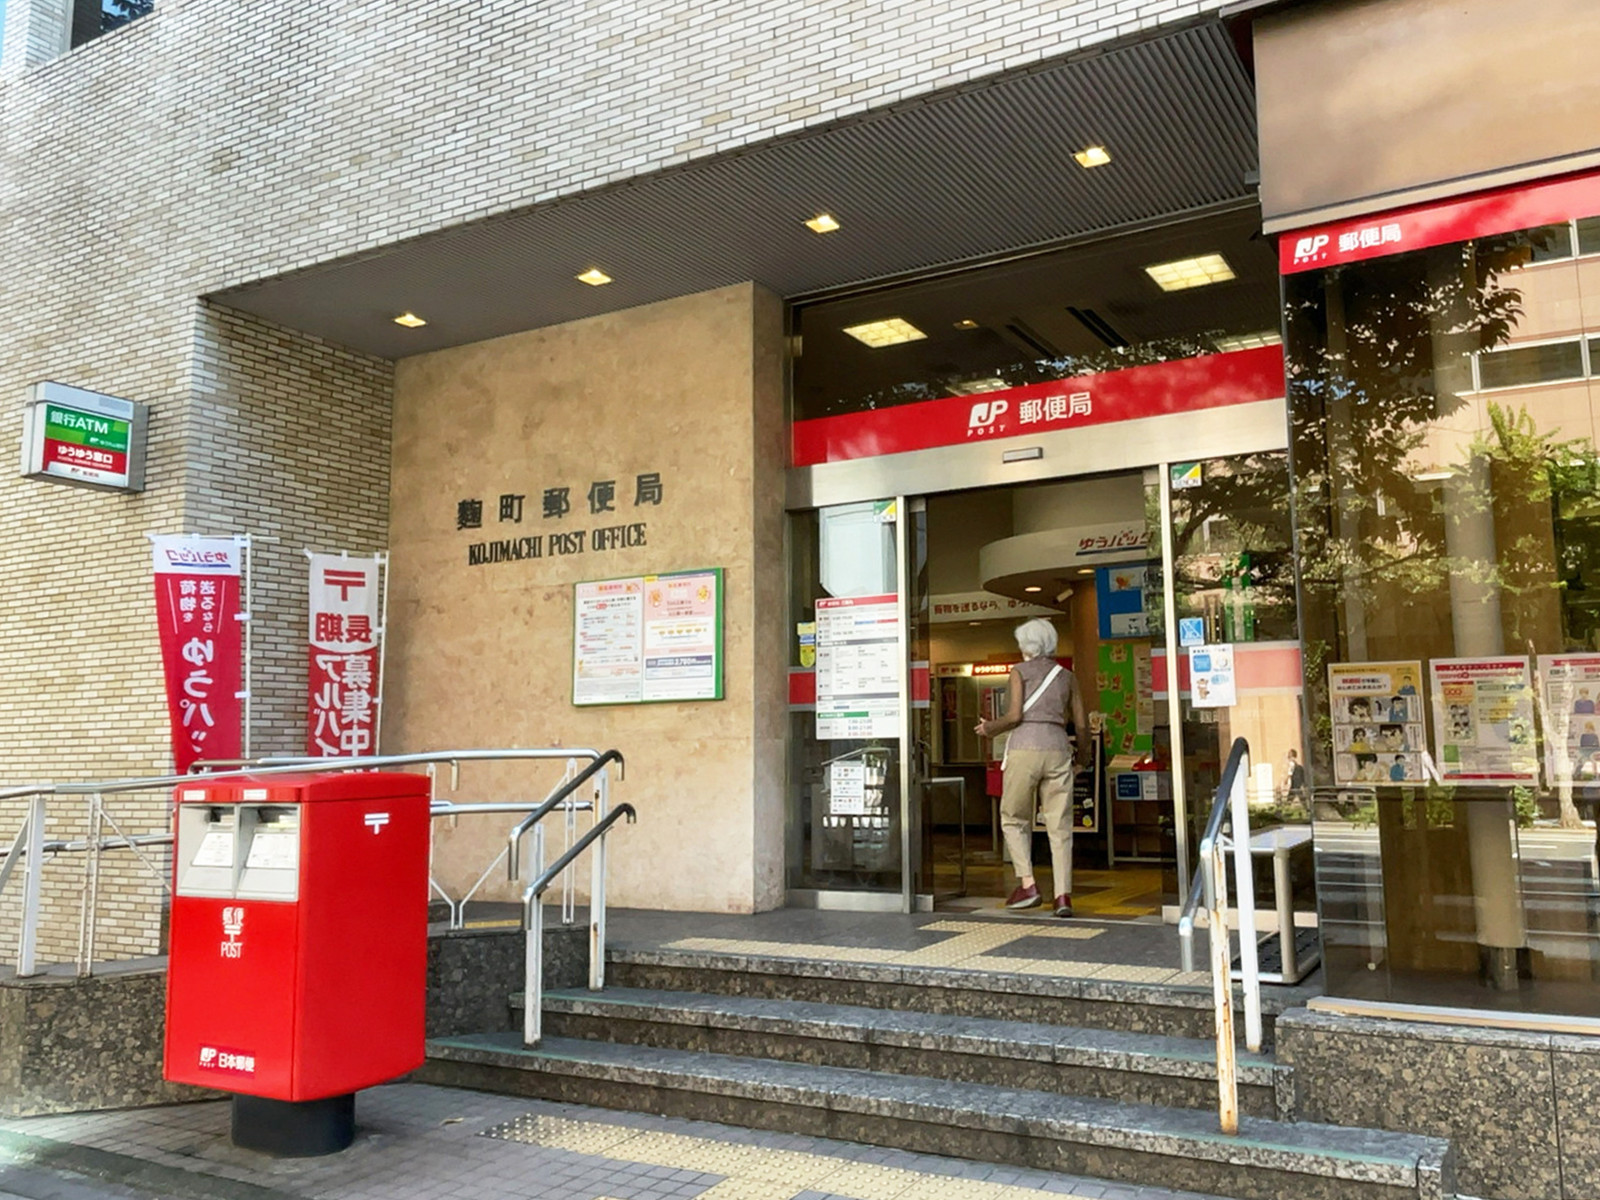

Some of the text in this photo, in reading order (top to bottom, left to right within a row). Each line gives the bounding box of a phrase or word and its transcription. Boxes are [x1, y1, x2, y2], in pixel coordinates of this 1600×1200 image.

[1338, 223, 1403, 253] 郵便局
[1293, 252, 1329, 265] POST
[1019, 391, 1093, 425] 郵便局
[50, 410, 109, 435] 銀行ATM
[966, 424, 1007, 438] POST
[57, 445, 114, 464] ゆうゆう窓口
[468, 522, 648, 567] KOJIMACHI POST OFFICE
[222, 906, 245, 926] 郵便
[220, 942, 244, 959] POST
[218, 1052, 255, 1073] 日本郵便
